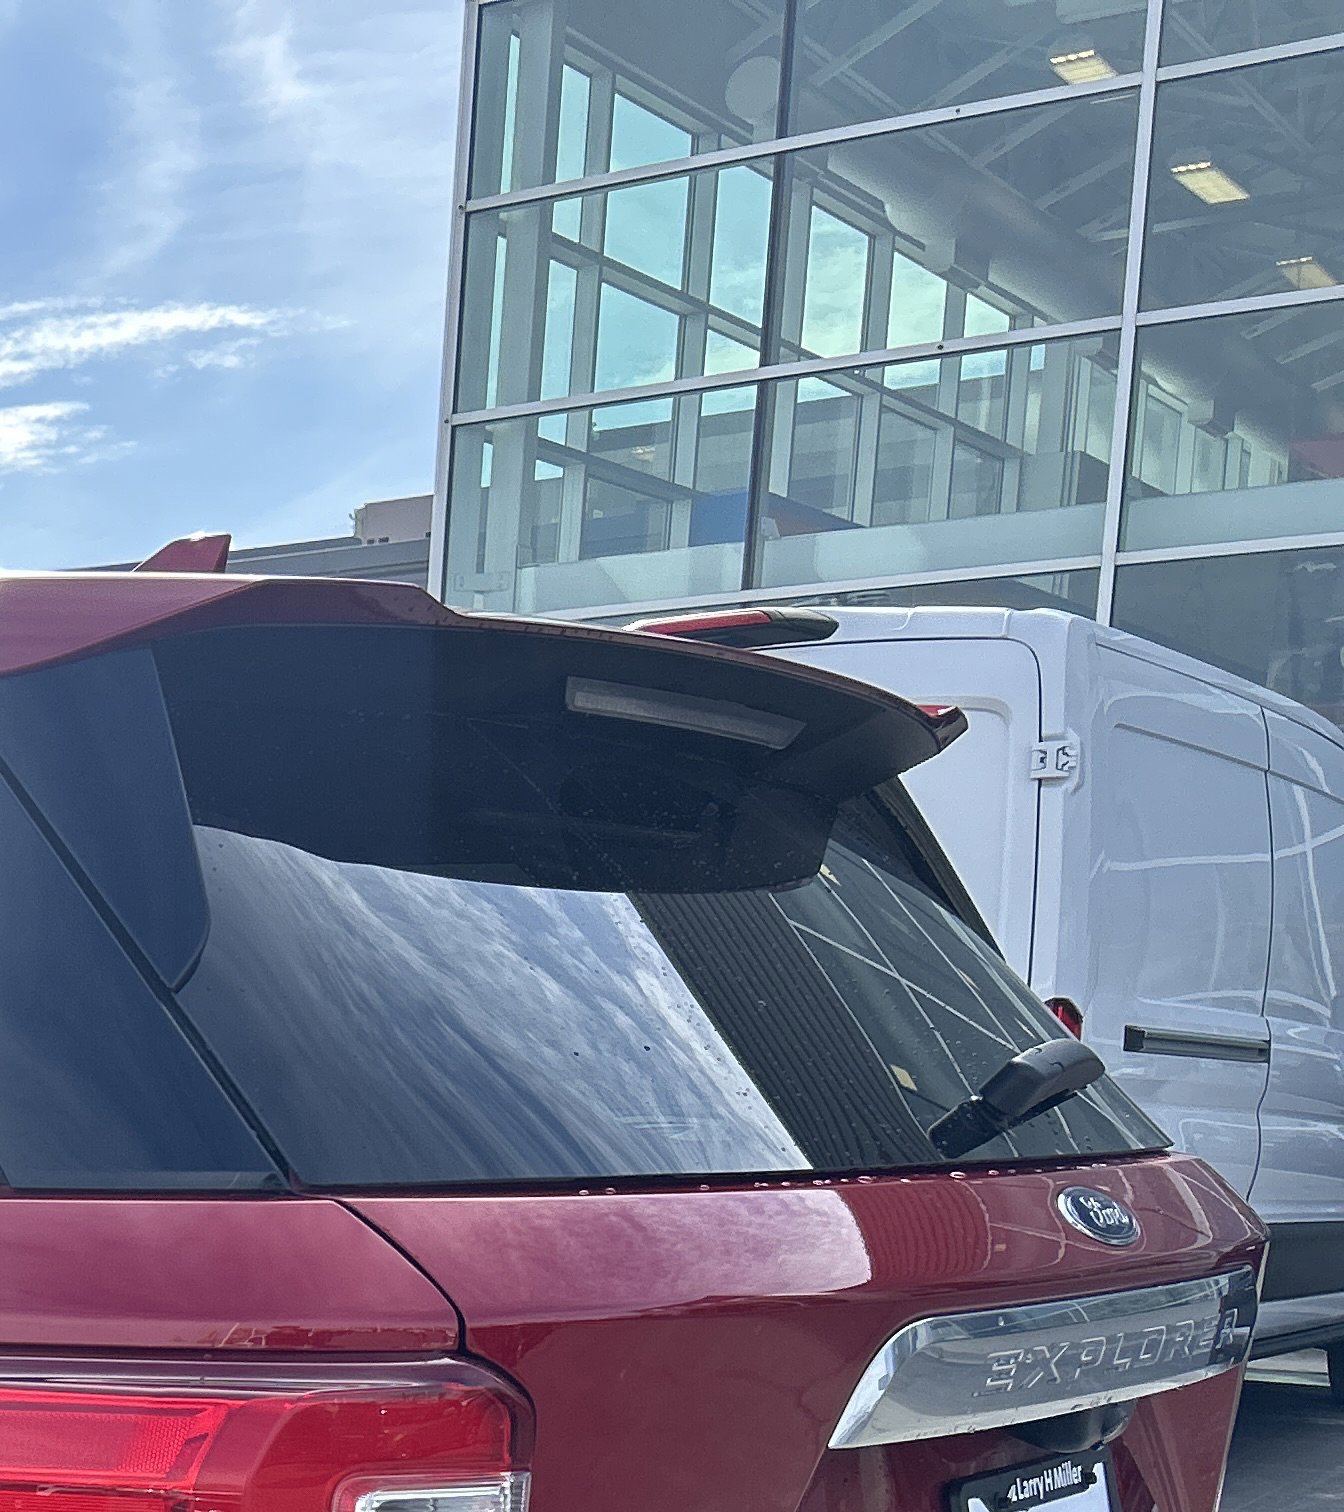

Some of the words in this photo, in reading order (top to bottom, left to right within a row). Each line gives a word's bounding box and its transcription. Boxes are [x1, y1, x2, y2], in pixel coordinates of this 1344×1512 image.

[979, 1307, 1239, 1396] EXPLORER
[1015, 1471, 1047, 1500] Larry
[1053, 1460, 1083, 1489] Miller
